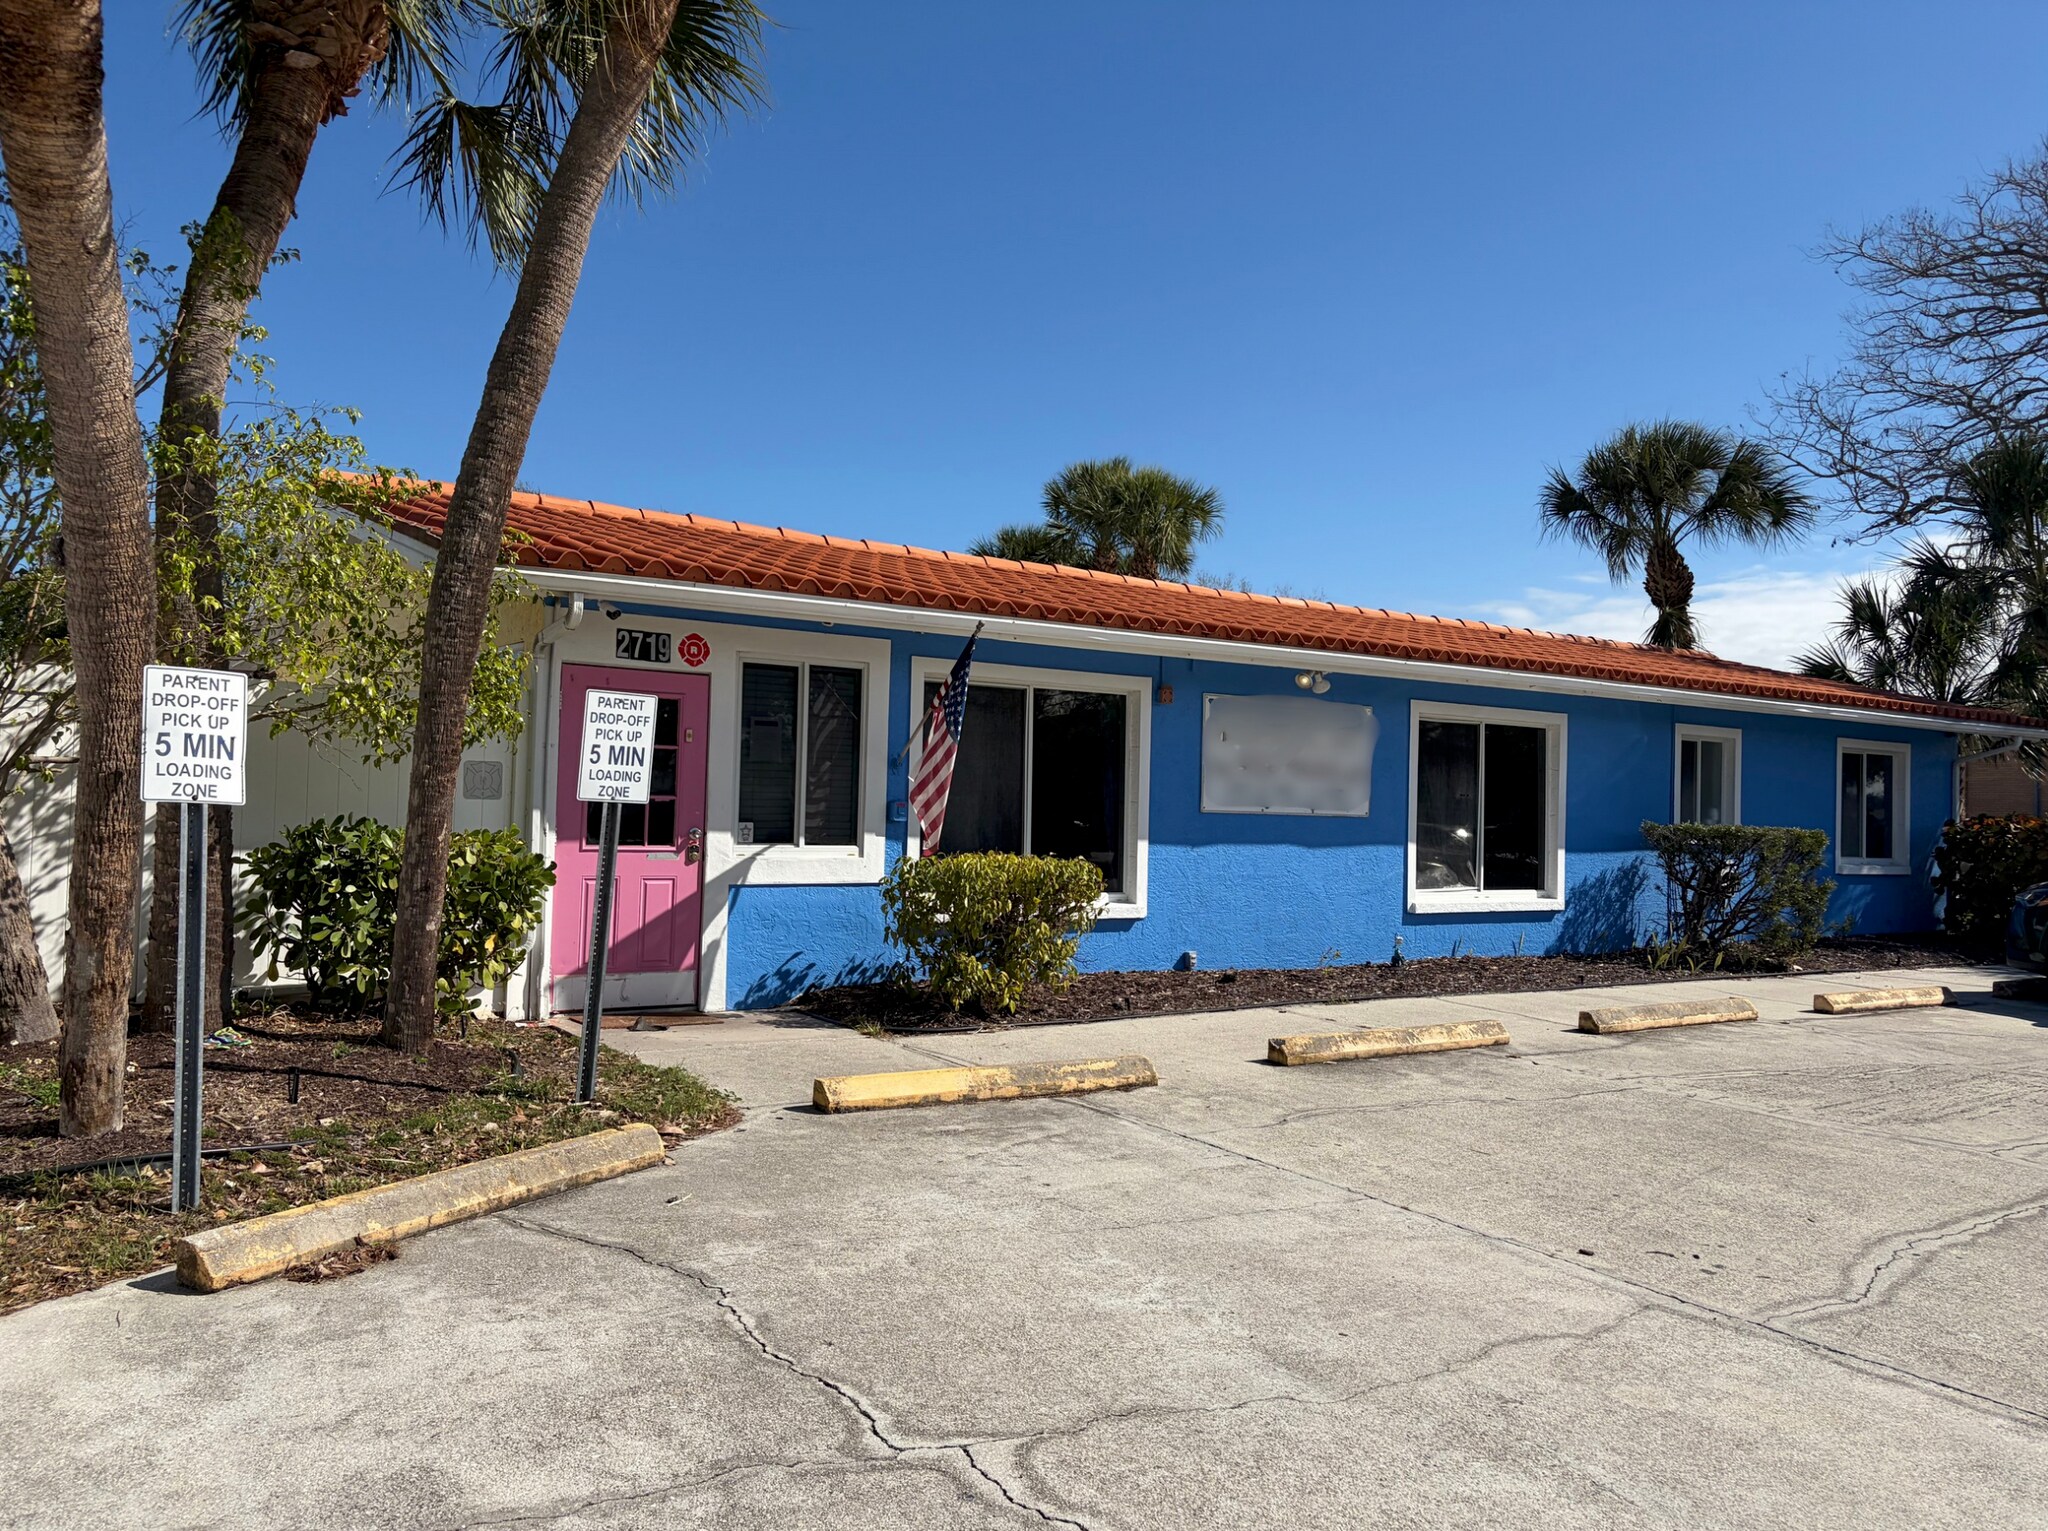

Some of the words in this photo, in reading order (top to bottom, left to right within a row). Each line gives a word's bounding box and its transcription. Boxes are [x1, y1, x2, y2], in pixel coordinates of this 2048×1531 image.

[617, 630, 670, 662] 2719
[162, 673, 231, 692] PARENT
[152, 692, 240, 712] DROP-OFF
[597, 696, 646, 712] PARENT
[162, 712, 202, 728] PICK
[208, 715, 230, 730] UP
[590, 711, 651, 727] DROP-OFF
[595, 728, 623, 742] PICK
[626, 730, 643, 742] UP
[155, 732, 172, 757] 5
[183, 733, 236, 761] MIN
[589, 744, 601, 765] 5
[608, 744, 645, 767] MIN
[156, 763, 232, 780] LOADING
[588, 769, 642, 783] LOADING
[171, 782, 218, 799] ZONE
[597, 785, 630, 798] ZONE
